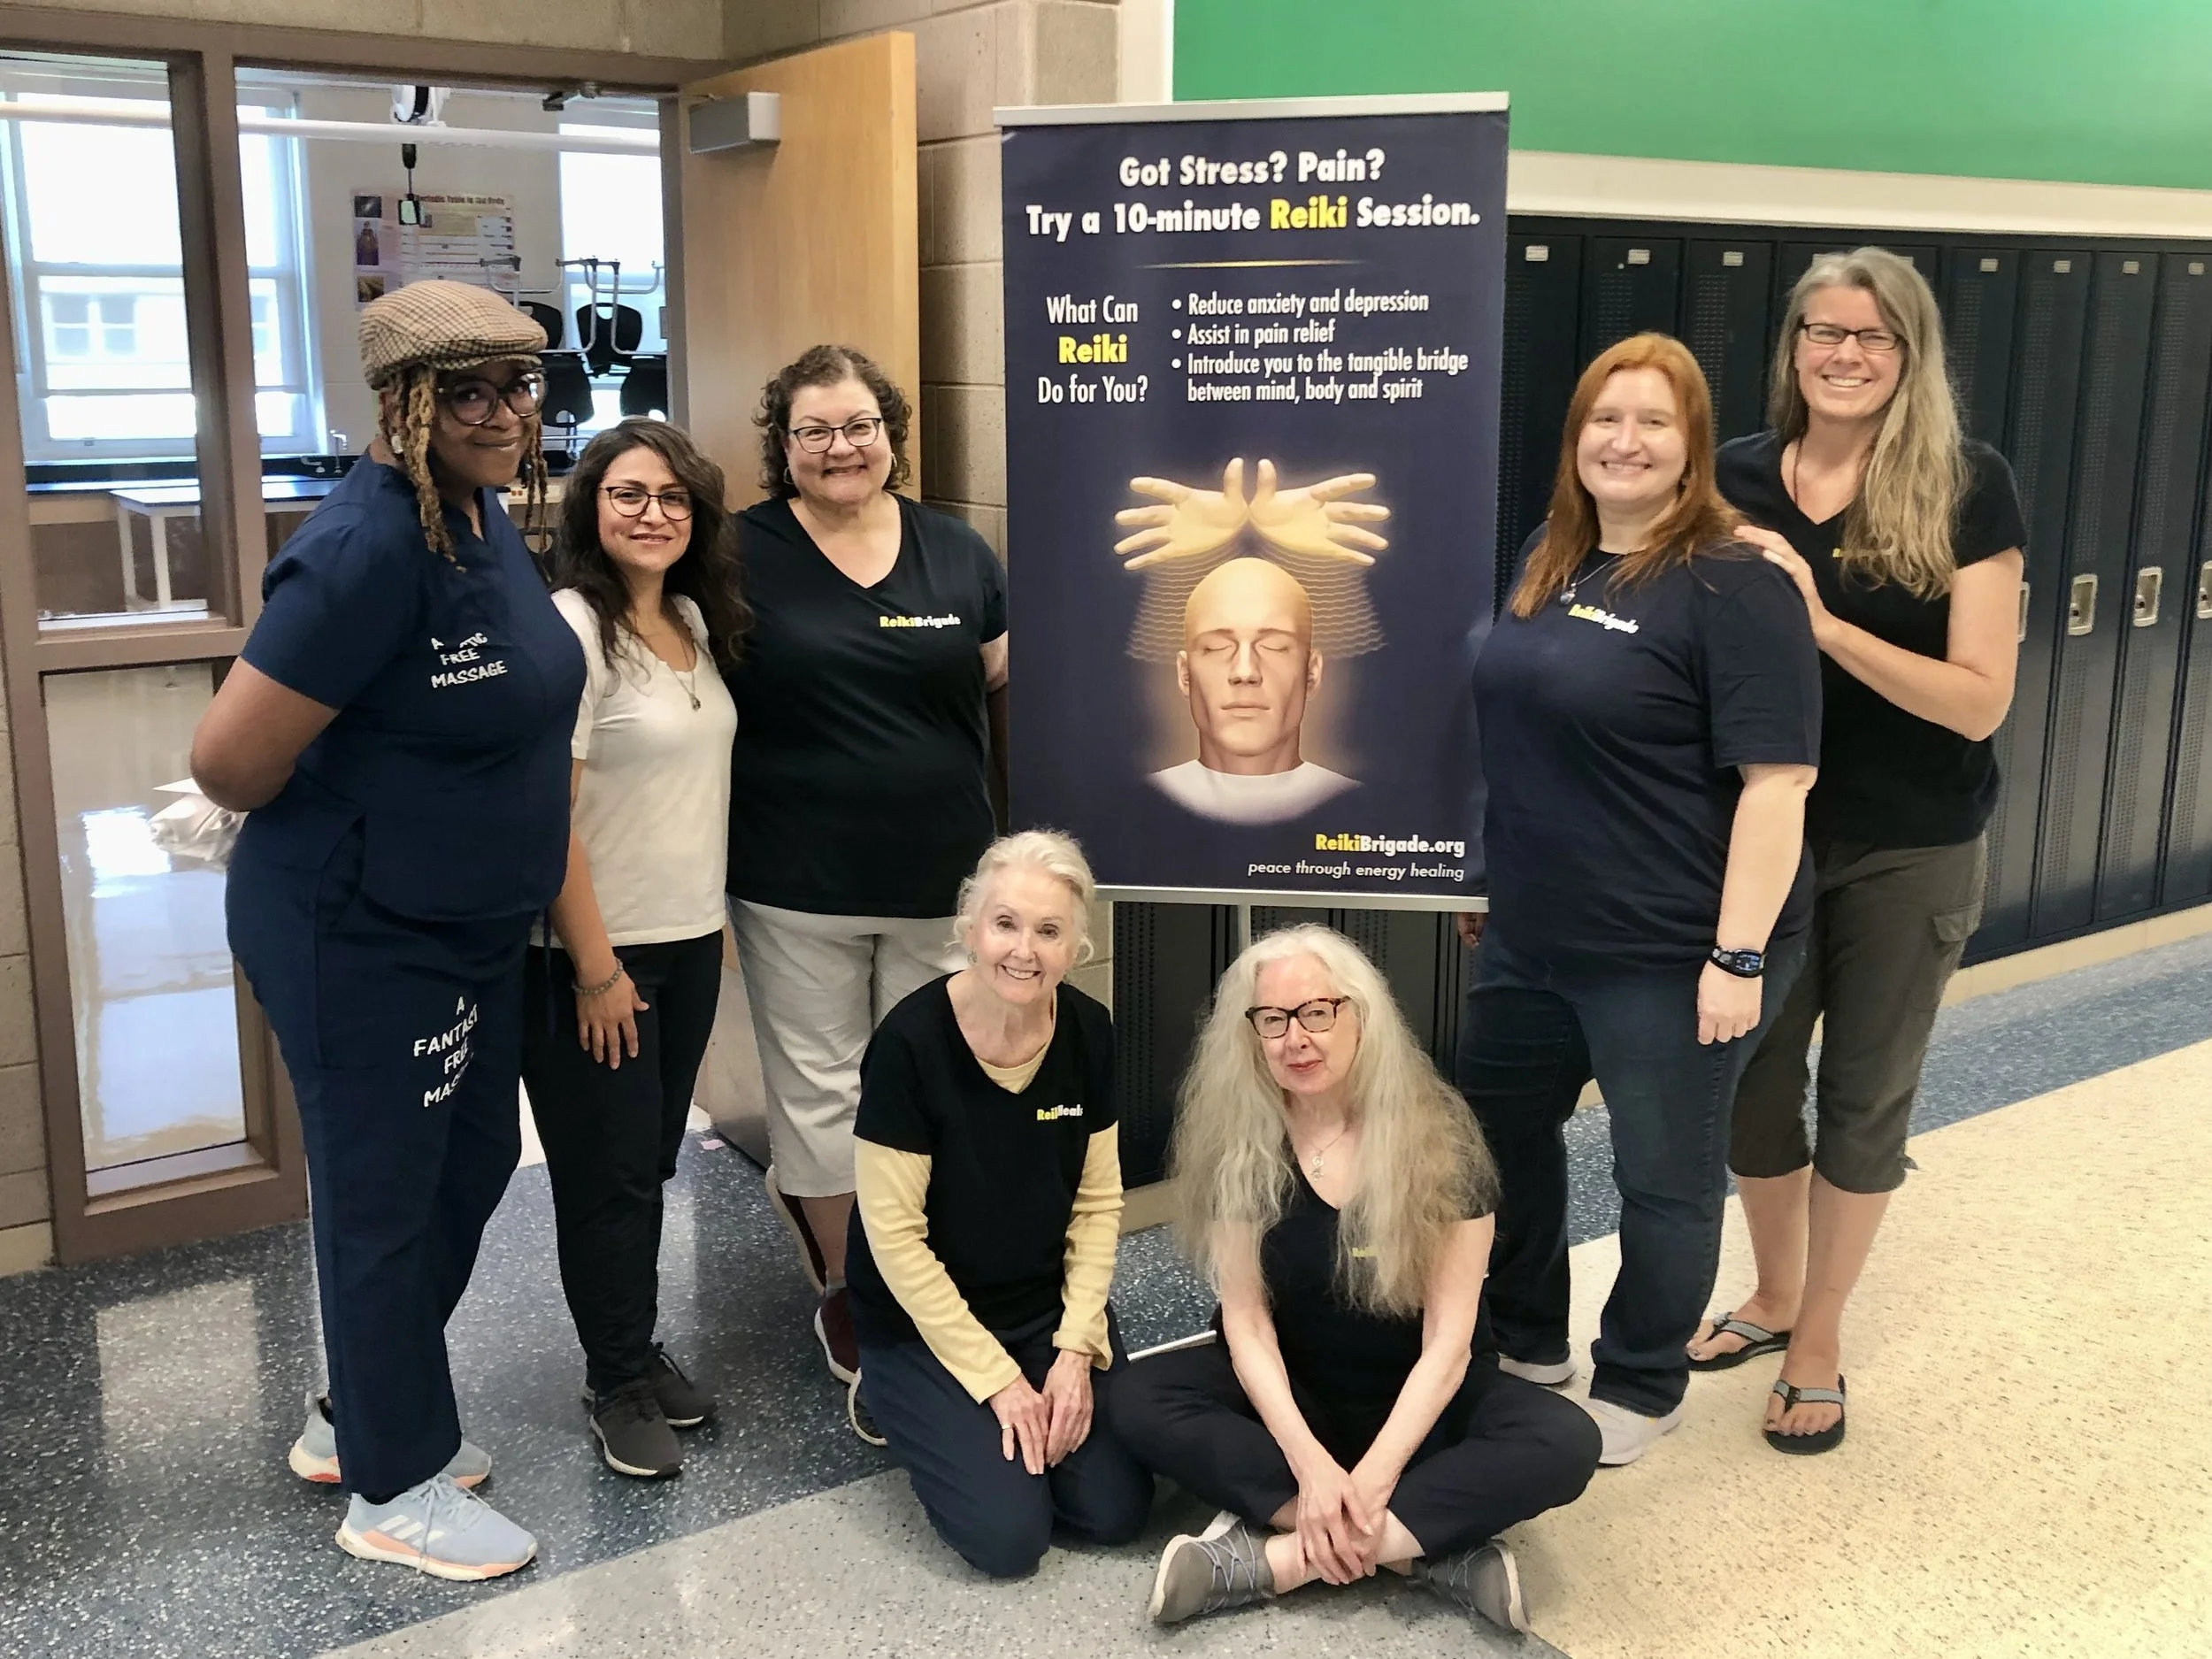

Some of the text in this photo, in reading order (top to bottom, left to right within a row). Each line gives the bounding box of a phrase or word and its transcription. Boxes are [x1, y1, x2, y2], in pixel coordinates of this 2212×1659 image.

[1119, 148, 1386, 187] Got Stress? Pain?
[1025, 193, 1480, 242] Try a 10-minute Reiki Session.
[1046, 294, 1139, 324] What Can
[1188, 288, 1429, 319] Reduce anxiety and depression
[1187, 318, 1336, 349] Assist in pain relief
[1058, 334, 1127, 364] Reiki
[1187, 346, 1469, 379] Introduce you to the tangible bridge
[1038, 373, 1148, 403] Do for You?
[1187, 375, 1423, 404] between mind, body and spirit
[879, 613, 961, 629] ReikiBrigade
[440, 648, 480, 665] FREE
[430, 660, 508, 688] MASSAGE
[1315, 833, 1465, 857] ReikiBrigade.org
[1248, 860, 1465, 881] peace through energy healing
[456, 995, 465, 1016] A
[413, 1003, 478, 1057] FANTAST
